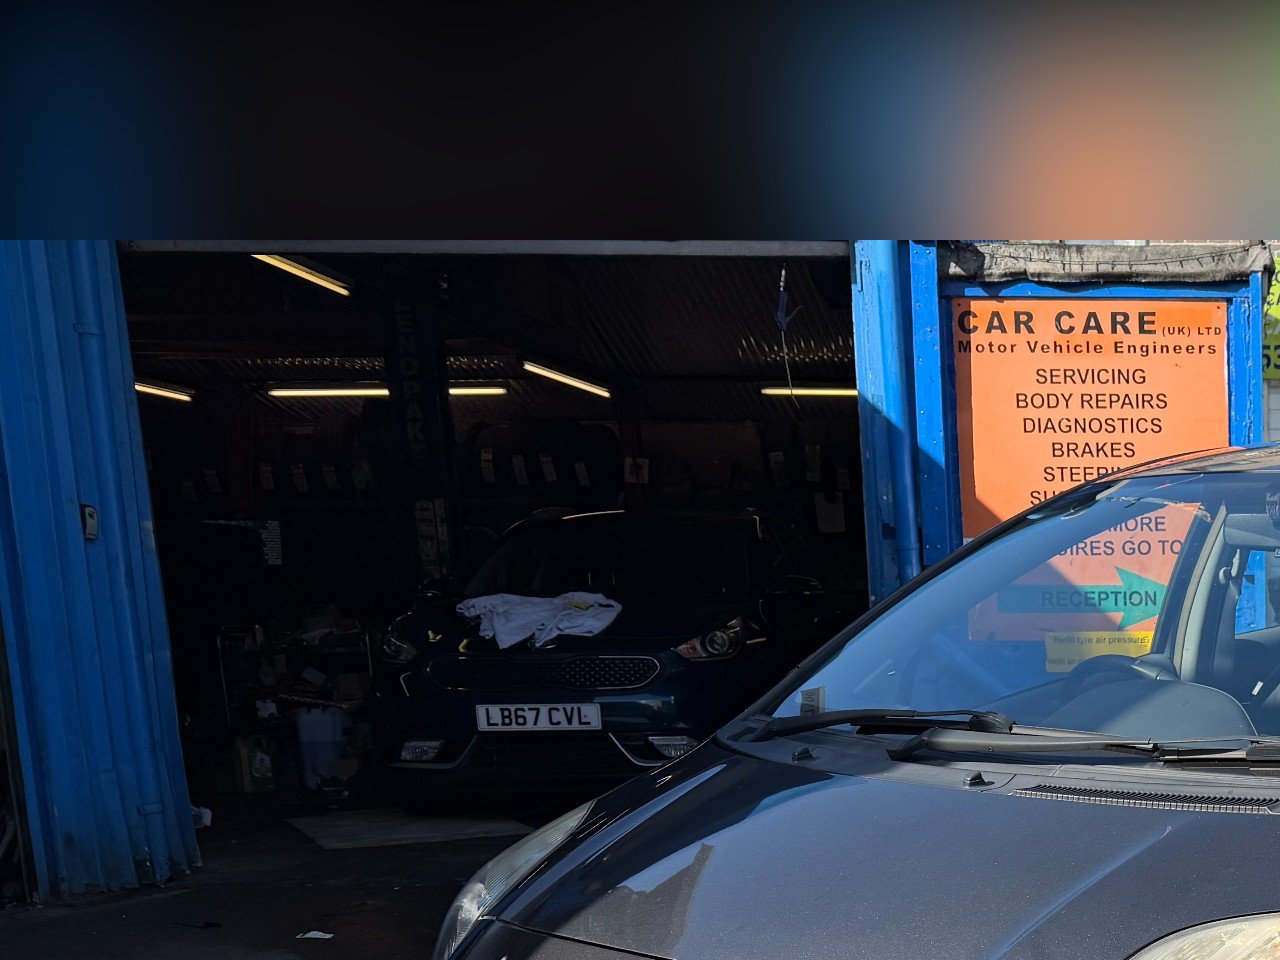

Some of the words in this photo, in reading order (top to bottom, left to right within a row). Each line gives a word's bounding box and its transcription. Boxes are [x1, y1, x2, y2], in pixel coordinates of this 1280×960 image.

[957, 310, 1036, 335] CAR
[1054, 311, 1157, 335] CARE
[1161, 326, 1192, 337] (UK)
[1197, 327, 1222, 335] LTD
[958, 341, 1017, 353] Motor
[1026, 340, 1104, 354] Vehicle
[1113, 341, 1217, 357] Engineers
[1035, 368, 1147, 385] SERVICING
[1016, 393, 1073, 410] BODY
[1080, 393, 1168, 410] REPAIRS
[1023, 417, 1163, 434] DIAGNOSTICS
[1051, 442, 1136, 459] BRAKES
[1122, 540, 1151, 555] GO
[1158, 540, 1182, 555] TO
[1042, 591, 1157, 607] RECEPTION
[1077, 636, 1093, 646] tyre
[485, 707, 540, 727] LB67
[547, 706, 591, 726] CVL
